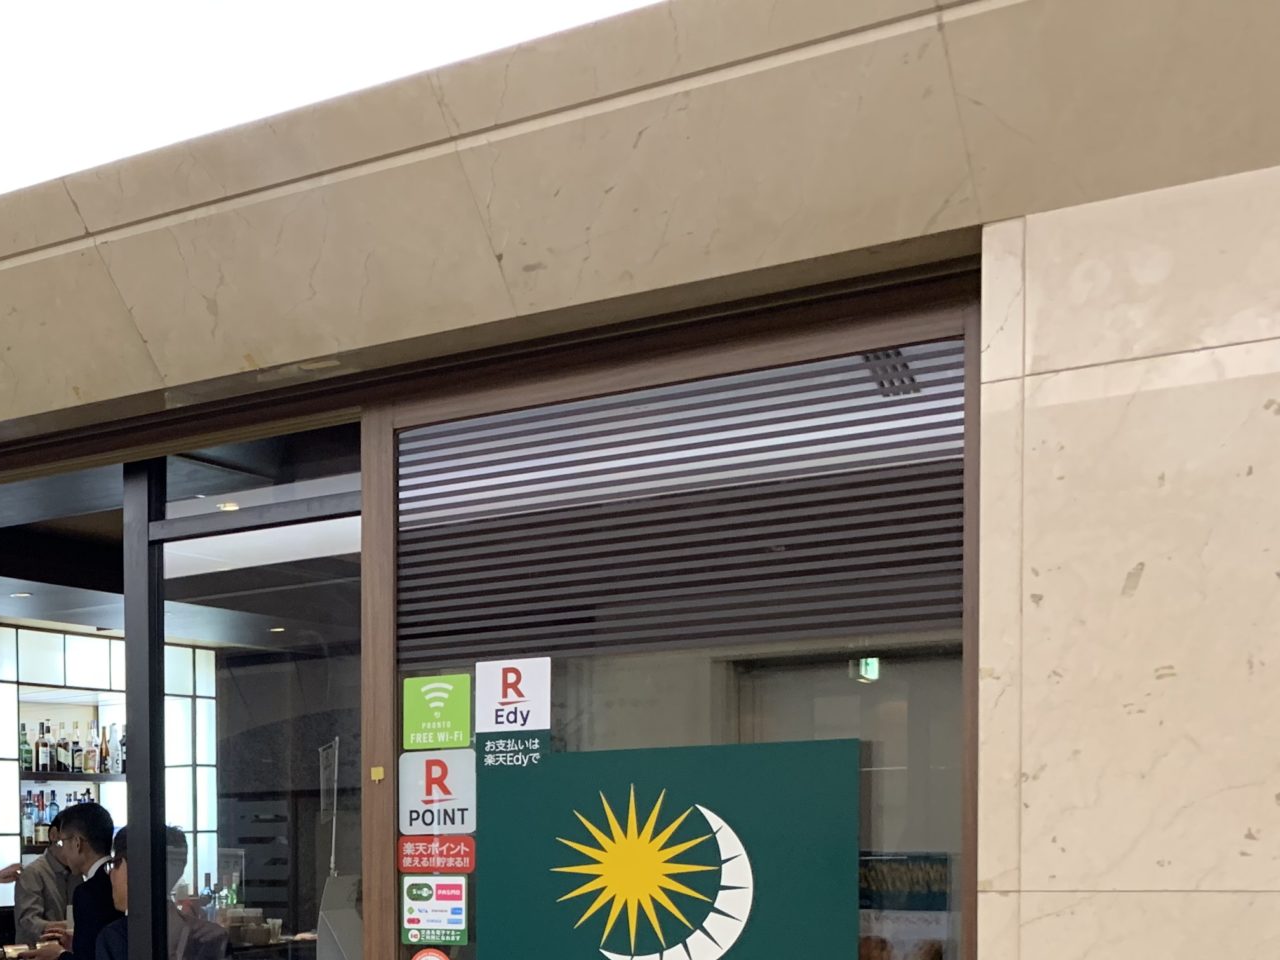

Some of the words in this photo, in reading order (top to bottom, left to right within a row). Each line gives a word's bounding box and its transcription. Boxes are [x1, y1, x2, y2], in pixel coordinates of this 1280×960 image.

[501, 667, 525, 699] R
[494, 707, 530, 727] Edy
[410, 733, 434, 744] FREE
[484, 738, 540, 752] お支払いは
[483, 753, 541, 767] 楽天Edyで
[425, 759, 452, 797] R
[409, 808, 469, 827] POINT
[403, 842, 470, 855] 楽天ポイント
